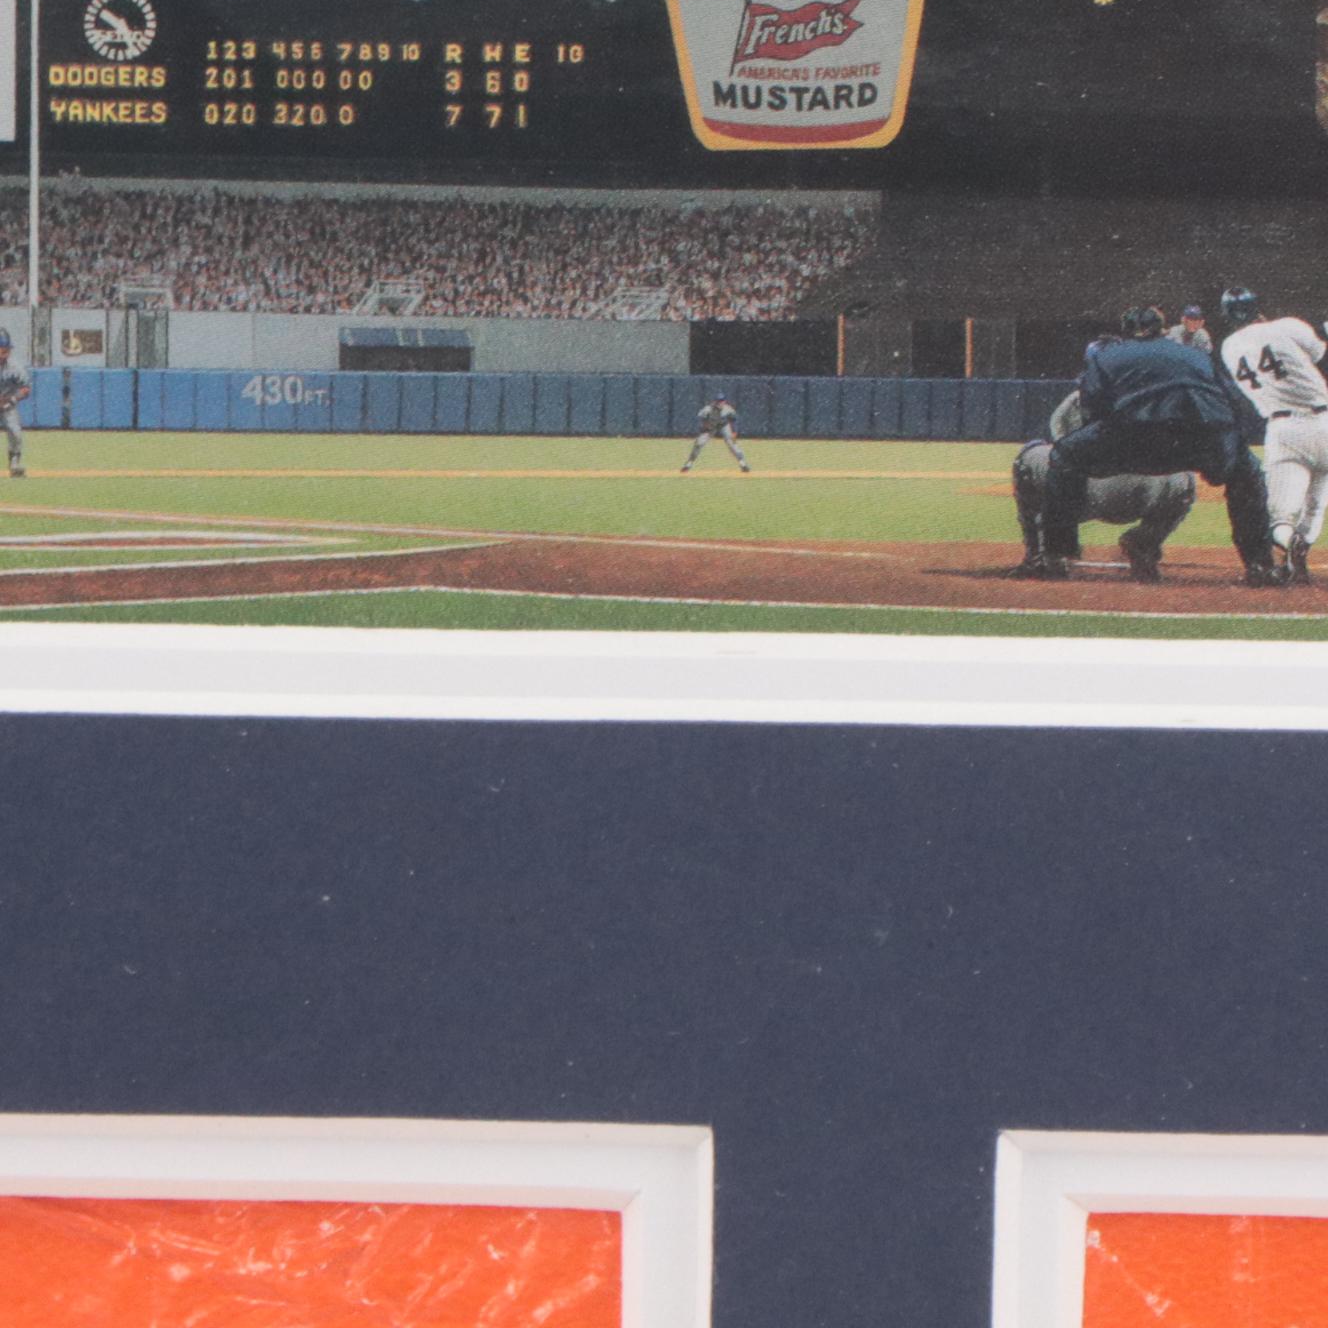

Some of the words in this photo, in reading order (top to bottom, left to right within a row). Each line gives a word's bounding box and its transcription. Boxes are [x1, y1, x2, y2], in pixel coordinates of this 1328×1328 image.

[445, 43, 462, 63] R
[515, 44, 531, 63] E
[49, 63, 166, 87] DODGERS
[446, 71, 462, 92] 3
[713, 81, 878, 112] MUSTARD
[50, 99, 167, 124] YANKEES
[446, 104, 462, 126] 7
[486, 104, 502, 128] 7
[1236, 344, 1288, 389] 44
